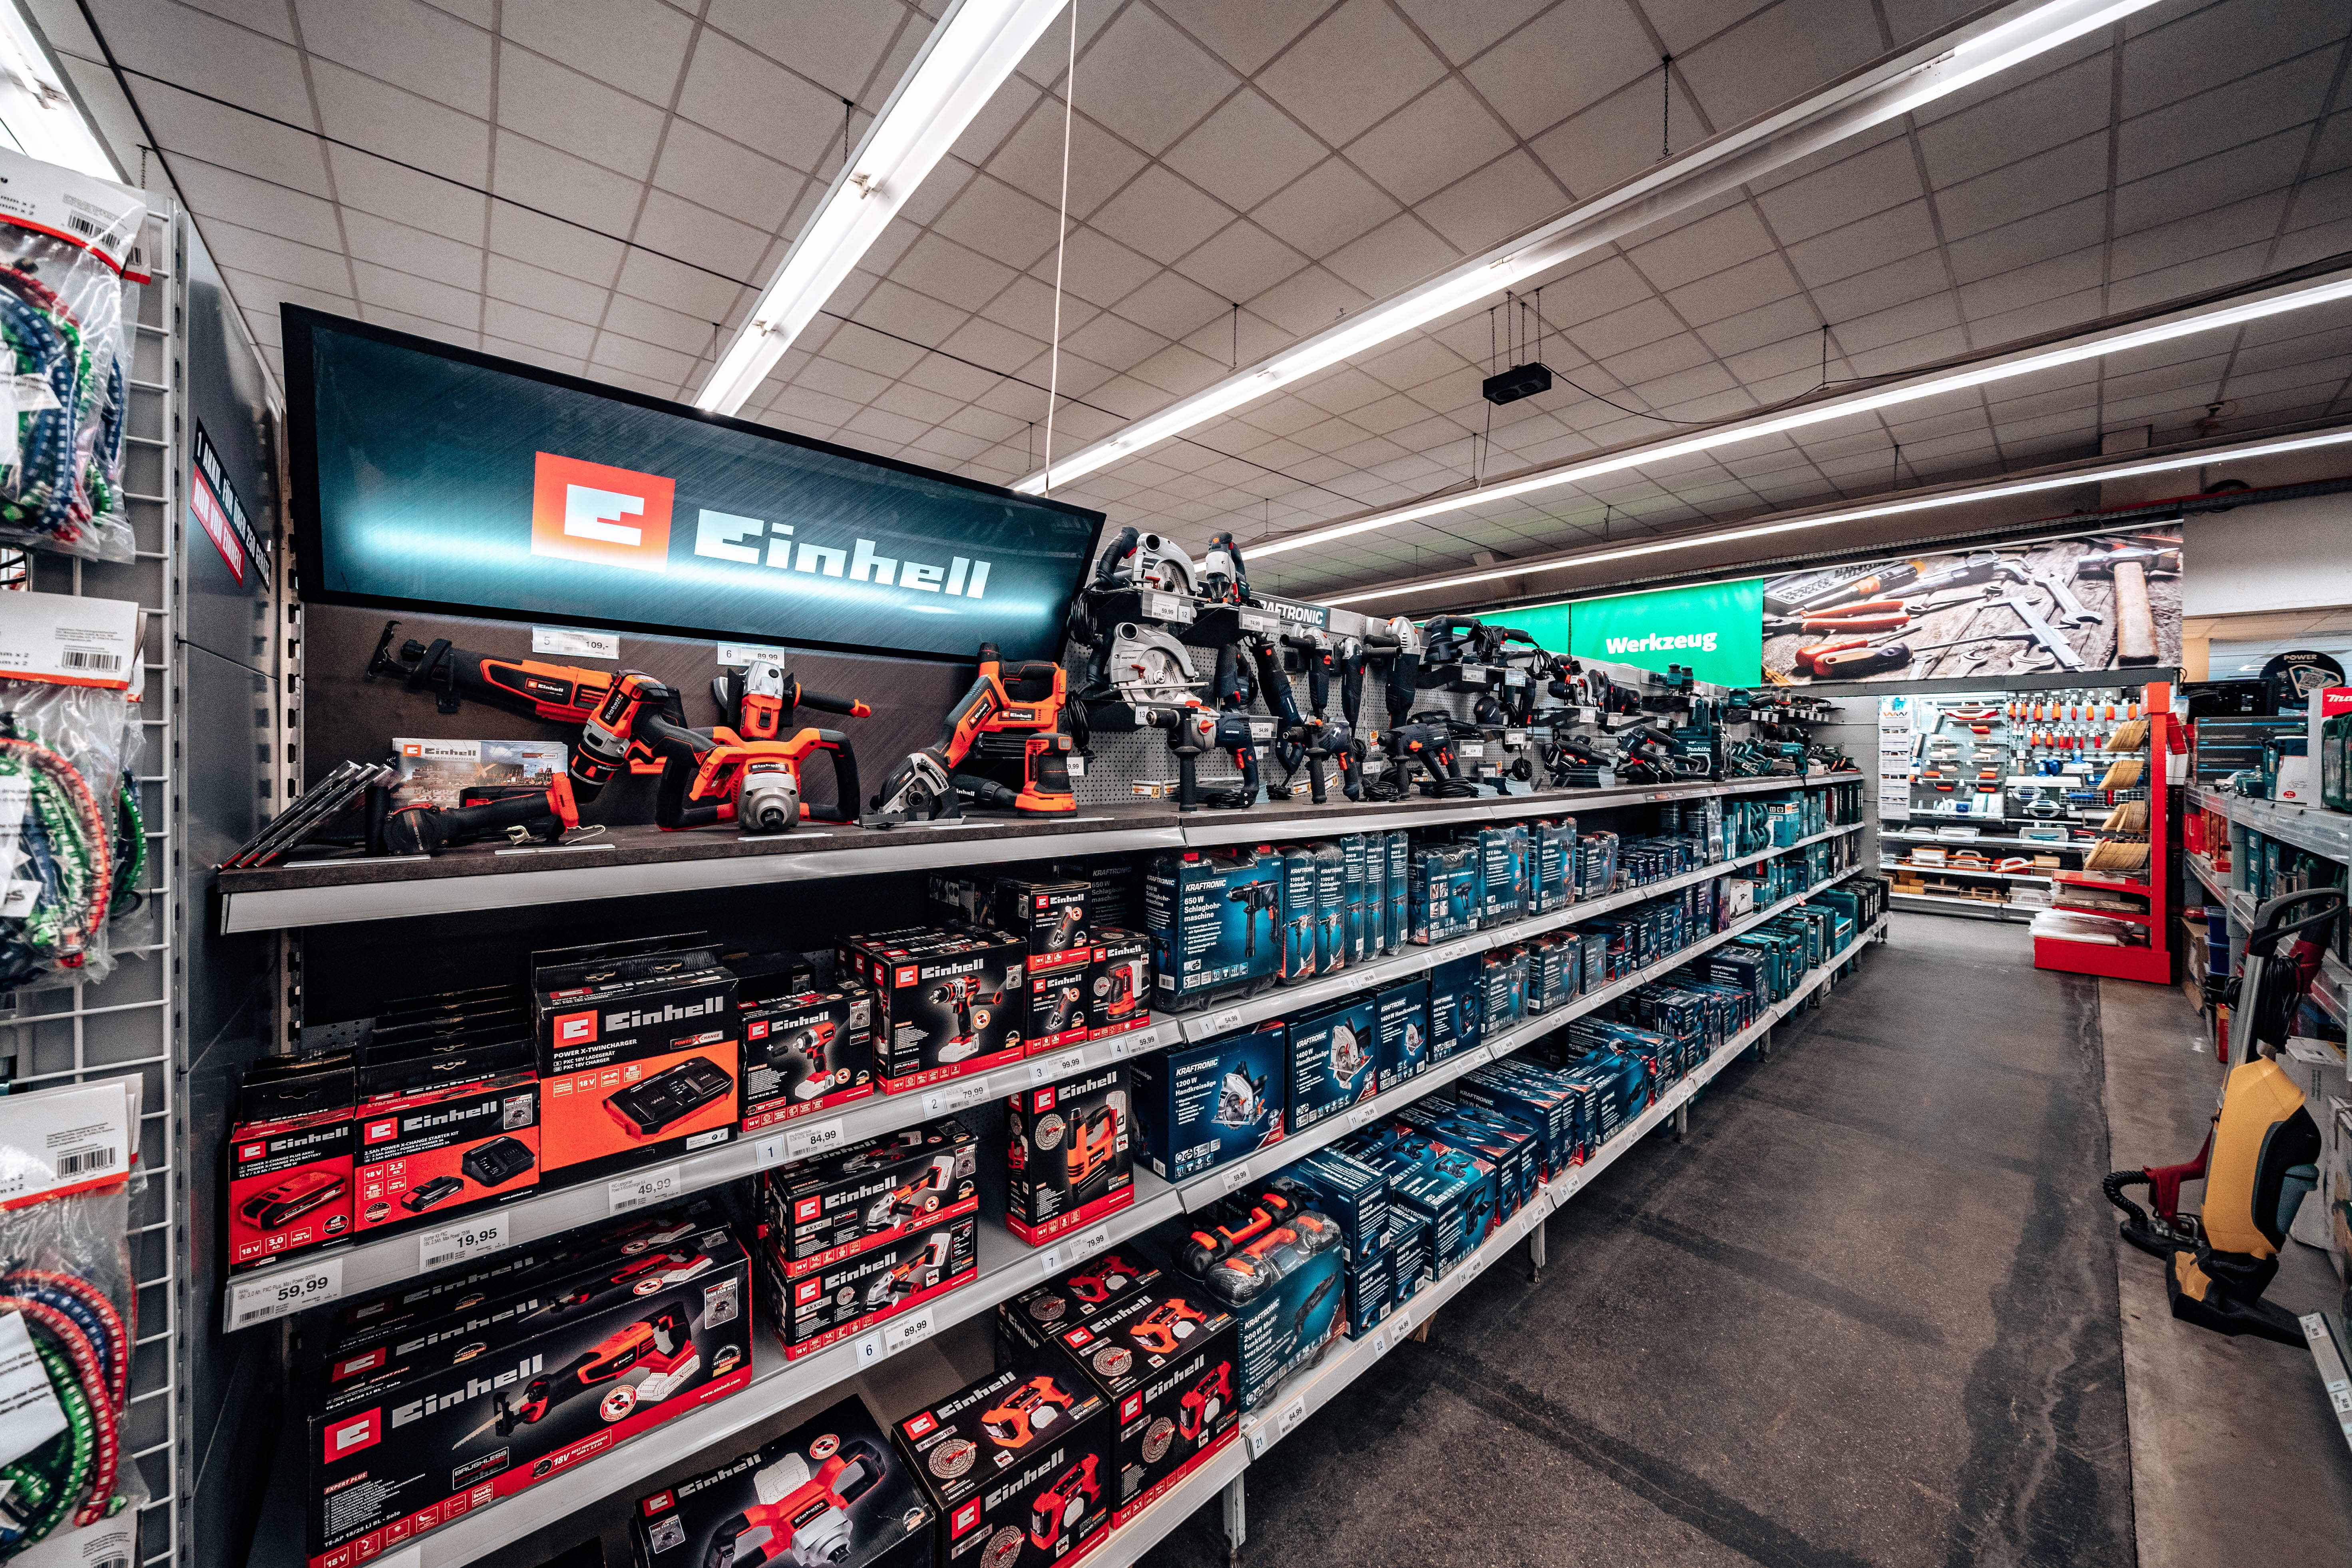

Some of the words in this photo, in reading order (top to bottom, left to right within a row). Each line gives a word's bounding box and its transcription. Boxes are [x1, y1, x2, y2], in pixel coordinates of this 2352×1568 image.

[194, 477, 209, 521] NUR
[210, 503, 222, 543] VON
[222, 478, 233, 516] FÜR
[233, 496, 246, 540] ÜBER
[246, 524, 256, 557] 250
[694, 509, 991, 599] Einhell
[1172, 569, 1183, 594] KRAFTRONIC
[1261, 600, 1323, 625] RAFTRONIC
[544, 636, 550, 645] 5
[585, 641, 609, 650] 109,-
[1606, 633, 1717, 654] Werkzeug
[538, 684, 563, 692] Einhell
[975, 703, 988, 718] Einhell
[1147, 875, 1175, 886] KRAFTRONIC
[1185, 880, 1226, 891] KRAFTRONIC
[1050, 894, 1084, 905] Einhell
[1184, 903, 1222, 913] Schlagbohr-
[1184, 912, 1214, 922] maschine
[909, 939, 972, 952] Einhell
[1107, 945, 1141, 957] Einhell
[922, 959, 983, 979] Einhell
[1710, 964, 1738, 972] KRAFTRONIC
[1047, 974, 1082, 987] Einhell
[1381, 999, 1406, 1012] KRAFTRONIC
[1433, 995, 1453, 1005] KRAFTRONIC
[606, 997, 723, 1032] Einhell
[772, 1011, 829, 1032] Einhell
[1139, 1036, 1154, 1046] 59,99
[1296, 1031, 1327, 1049] KRAFTRONIC
[554, 1050, 579, 1059] POWER
[581, 1039, 637, 1054] X-TWINCHARGER
[586, 1051, 615, 1060] LADEGERÄT
[585, 1057, 610, 1066] CHARGER
[1062, 1059, 1079, 1069] 99,99
[1296, 1050, 1329, 1067] Handkreissäge
[1037, 1069, 1042, 1077] 3
[1176, 1058, 1218, 1077] KRAFTRONIC
[1059, 1071, 1116, 1101] Einhell
[1176, 1079, 1190, 1088] 1200
[1176, 1080, 1216, 1096] Handkreissäge
[963, 1087, 983, 1099] 79,99
[1460, 1090, 1494, 1106] KRAFTRONIC
[931, 1099, 937, 1109] 2
[404, 1101, 497, 1132] Einhell
[271, 1126, 348, 1152] Einhell
[401, 1138, 427, 1147] X-CHANGE
[810, 1130, 836, 1144] 84,99
[768, 1146, 773, 1157] 1
[390, 1162, 403, 1171] 2.5
[1234, 1171, 1246, 1181] 59,99
[638, 1178, 671, 1194] 49,99
[825, 1176, 896, 1209] Einhell
[500, 1190, 532, 1201] www.einhell.com
[1359, 1188, 1382, 1206] KRAFTRONIC
[805, 1222, 823, 1232] AXXIO
[269, 1237, 284, 1246] 3.0
[457, 1228, 497, 1248] 19,95
[1087, 1236, 1104, 1248] 79,99
[1049, 1258, 1054, 1267] 7
[1359, 1260, 1383, 1280] KRAFTRONIC
[825, 1252, 896, 1290] Einhell
[278, 1277, 328, 1301] 59,99
[805, 1301, 823, 1312] AXXIO
[1090, 1295, 1152, 1333] Einhell
[1245, 1299, 1279, 1329] KRAFTRONIC
[396, 1299, 538, 1356] Einhell
[904, 1321, 927, 1337] 89,99
[1244, 1331, 1256, 1343] 200
[1264, 1315, 1278, 1329] Multi-
[1398, 1320, 1409, 1333] 94,99
[1082, 1338, 1109, 1355] PRESSITO
[1244, 1328, 1273, 1351] funktions-
[866, 1345, 873, 1356] 6
[1244, 1337, 1272, 1359] werkzeug
[714, 1355, 731, 1366] GERMAN
[1146, 1354, 1204, 1403] Einhell
[392, 1354, 542, 1429] Einhell
[700, 1378, 741, 1399] www.einhell.com
[937, 1372, 1017, 1419] Einhell
[1289, 1407, 1302, 1421] 64,99
[1123, 1418, 1149, 1439] PRESSITO
[921, 1428, 954, 1449] PRESSITO
[456, 1450, 507, 1476] BRUSHLESS
[553, 1452, 571, 1466] 18V
[326, 1480, 351, 1493] EXPERT
[351, 1472, 366, 1482] PLUS
[679, 1454, 761, 1498] Einhell
[985, 1448, 1064, 1512] Einhell
[956, 1528, 990, 1554] PRESSITO
[326, 1557, 338, 1568] 18
